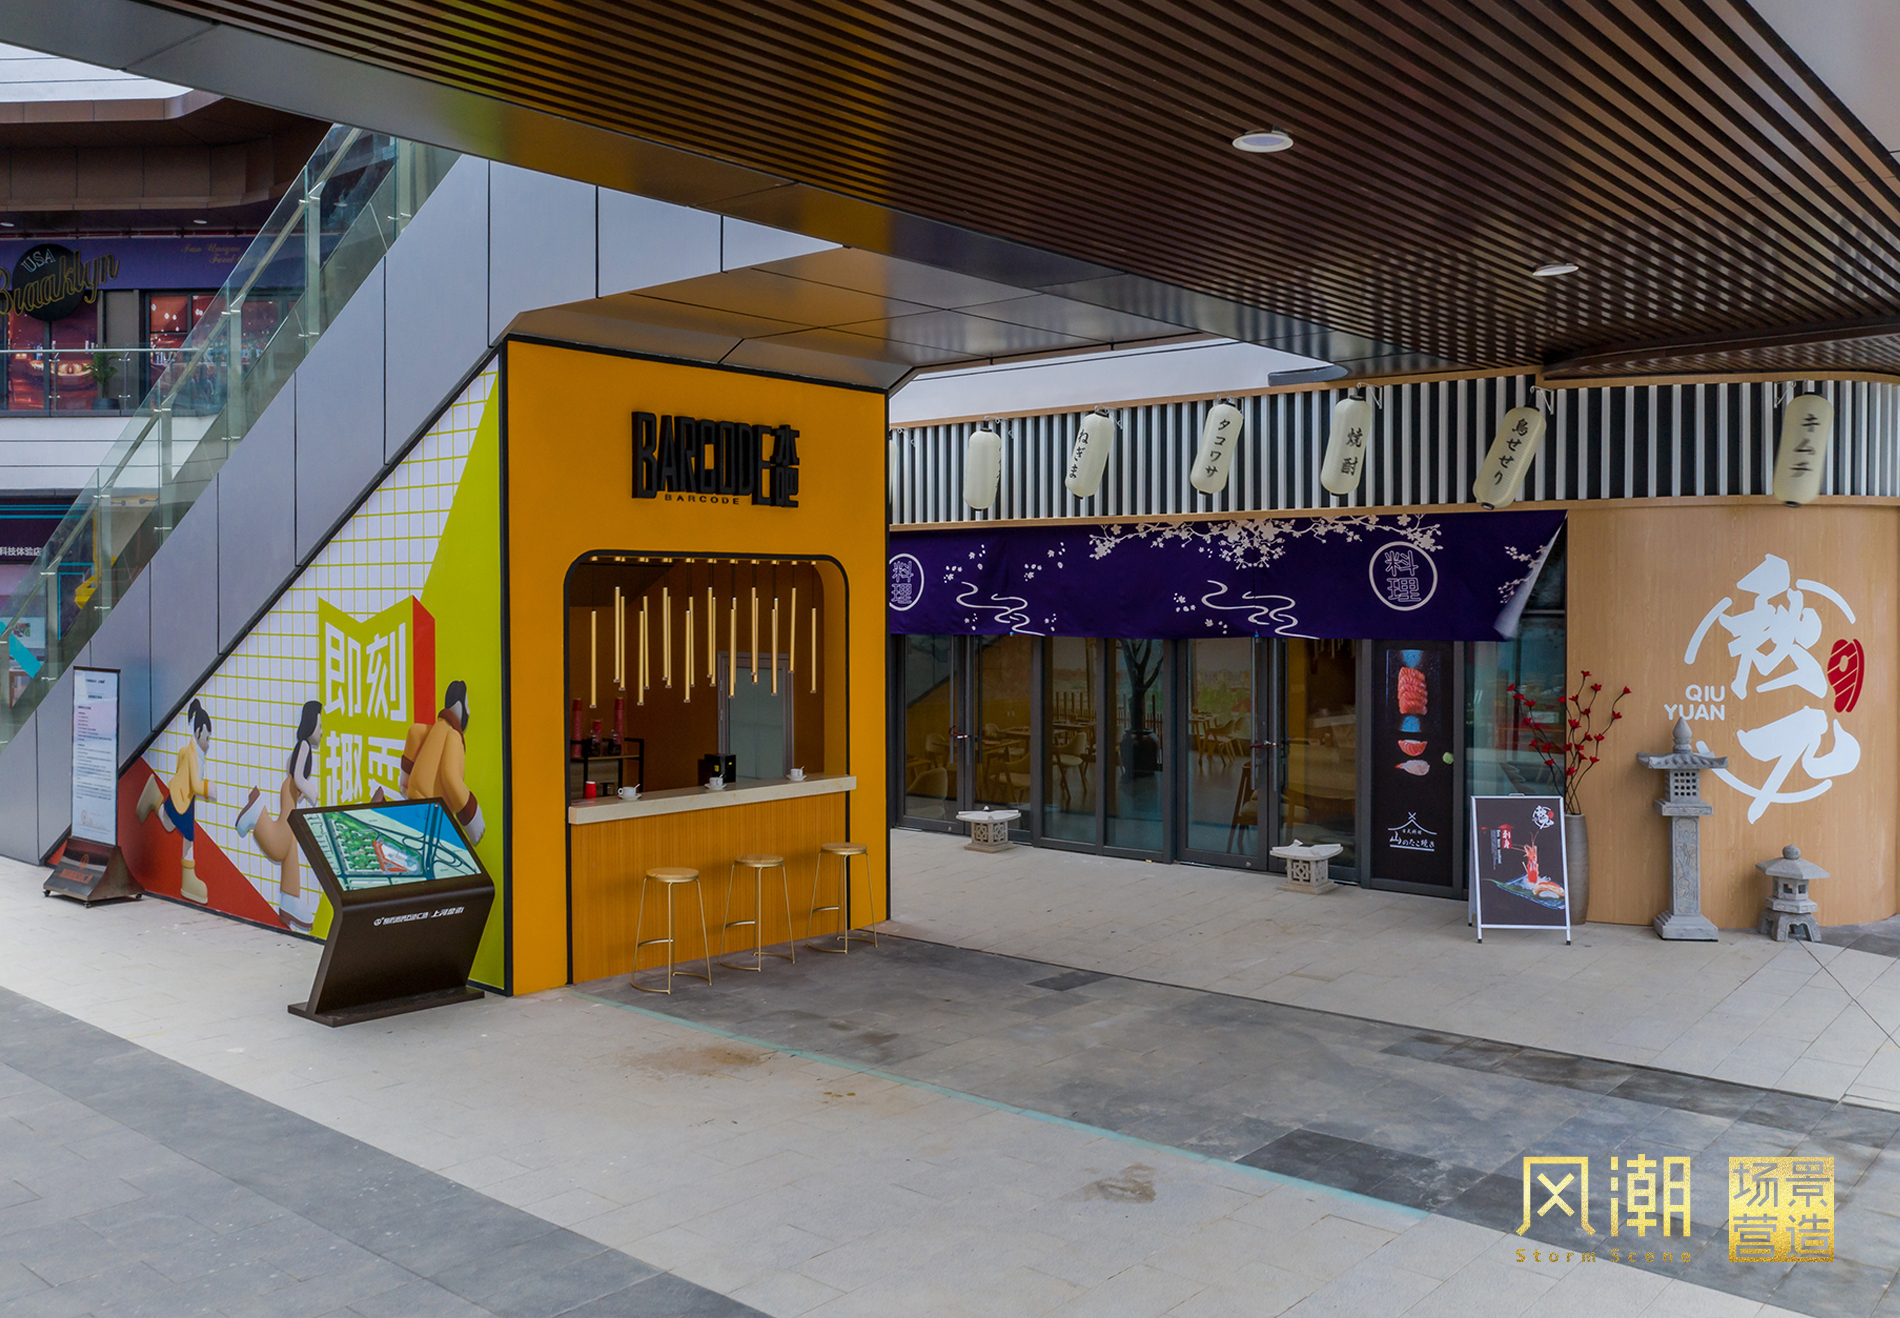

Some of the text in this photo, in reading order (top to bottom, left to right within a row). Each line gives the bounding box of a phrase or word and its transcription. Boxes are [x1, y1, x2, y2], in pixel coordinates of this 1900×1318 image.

[21, 248, 56, 273] USA
[631, 411, 772, 506] BARCODE
[1069, 429, 1089, 479] ねぎま
[1205, 418, 1231, 478] タコワサ
[664, 494, 740, 505] BARCODE
[891, 560, 914, 604] 料理
[1384, 550, 1422, 603] 料理
[324, 621, 407, 722] 即刻
[1685, 684, 1725, 702] QIU
[1664, 704, 1725, 721] YUAN
